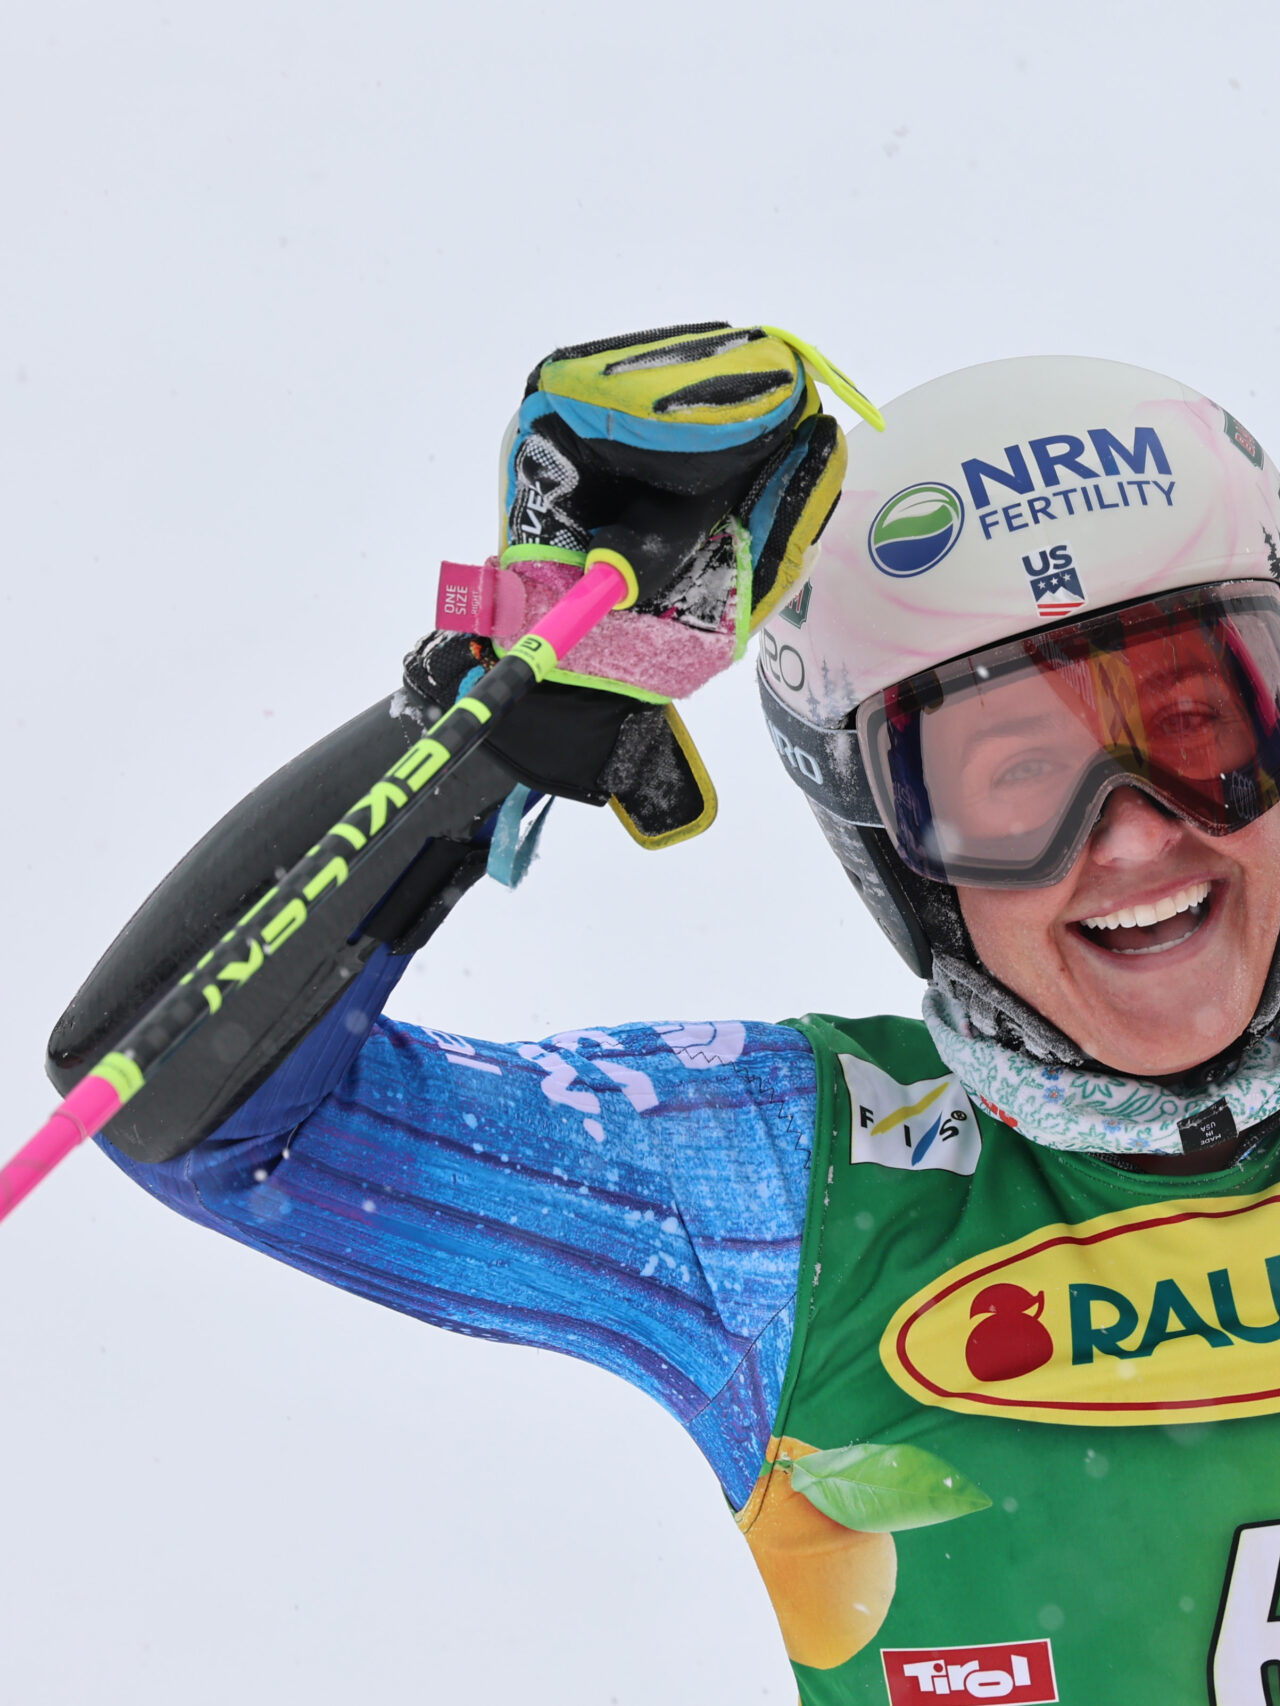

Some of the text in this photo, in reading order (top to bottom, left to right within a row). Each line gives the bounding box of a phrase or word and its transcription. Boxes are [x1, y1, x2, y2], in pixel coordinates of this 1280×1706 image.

[961, 427, 1173, 510] NRM
[979, 480, 1177, 540] FERTILITY
[1022, 545, 1073, 577] US
[444, 584, 457, 614] ONE
[455, 585, 468, 616] SIZE
[470, 590, 480, 615] RIGHT
[329, 698, 492, 850] LEKI
[1200, 1121, 1217, 1132] USA
[1200, 1133, 1222, 1146] MADE
[903, 1654, 1032, 1698] Tirol
